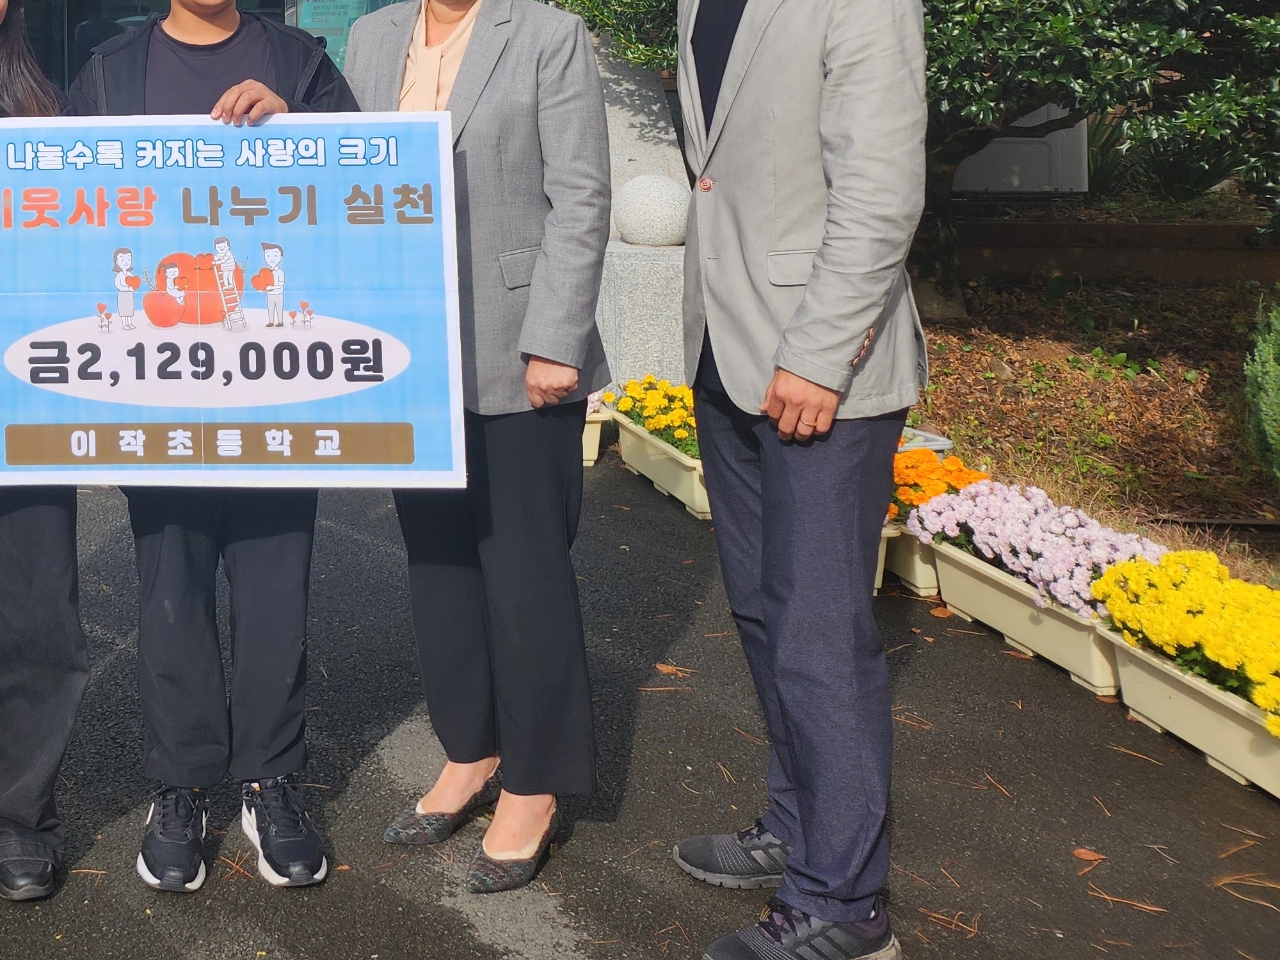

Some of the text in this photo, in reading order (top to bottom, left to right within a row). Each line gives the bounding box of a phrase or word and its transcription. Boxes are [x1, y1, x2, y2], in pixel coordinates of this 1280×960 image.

[6, 135, 399, 171] 나눌수록 커지는 사랑의 크기
[181, 183, 318, 227] 나누기
[343, 182, 435, 227] 실천
[27, 338, 385, 387] 금2,129,000원
